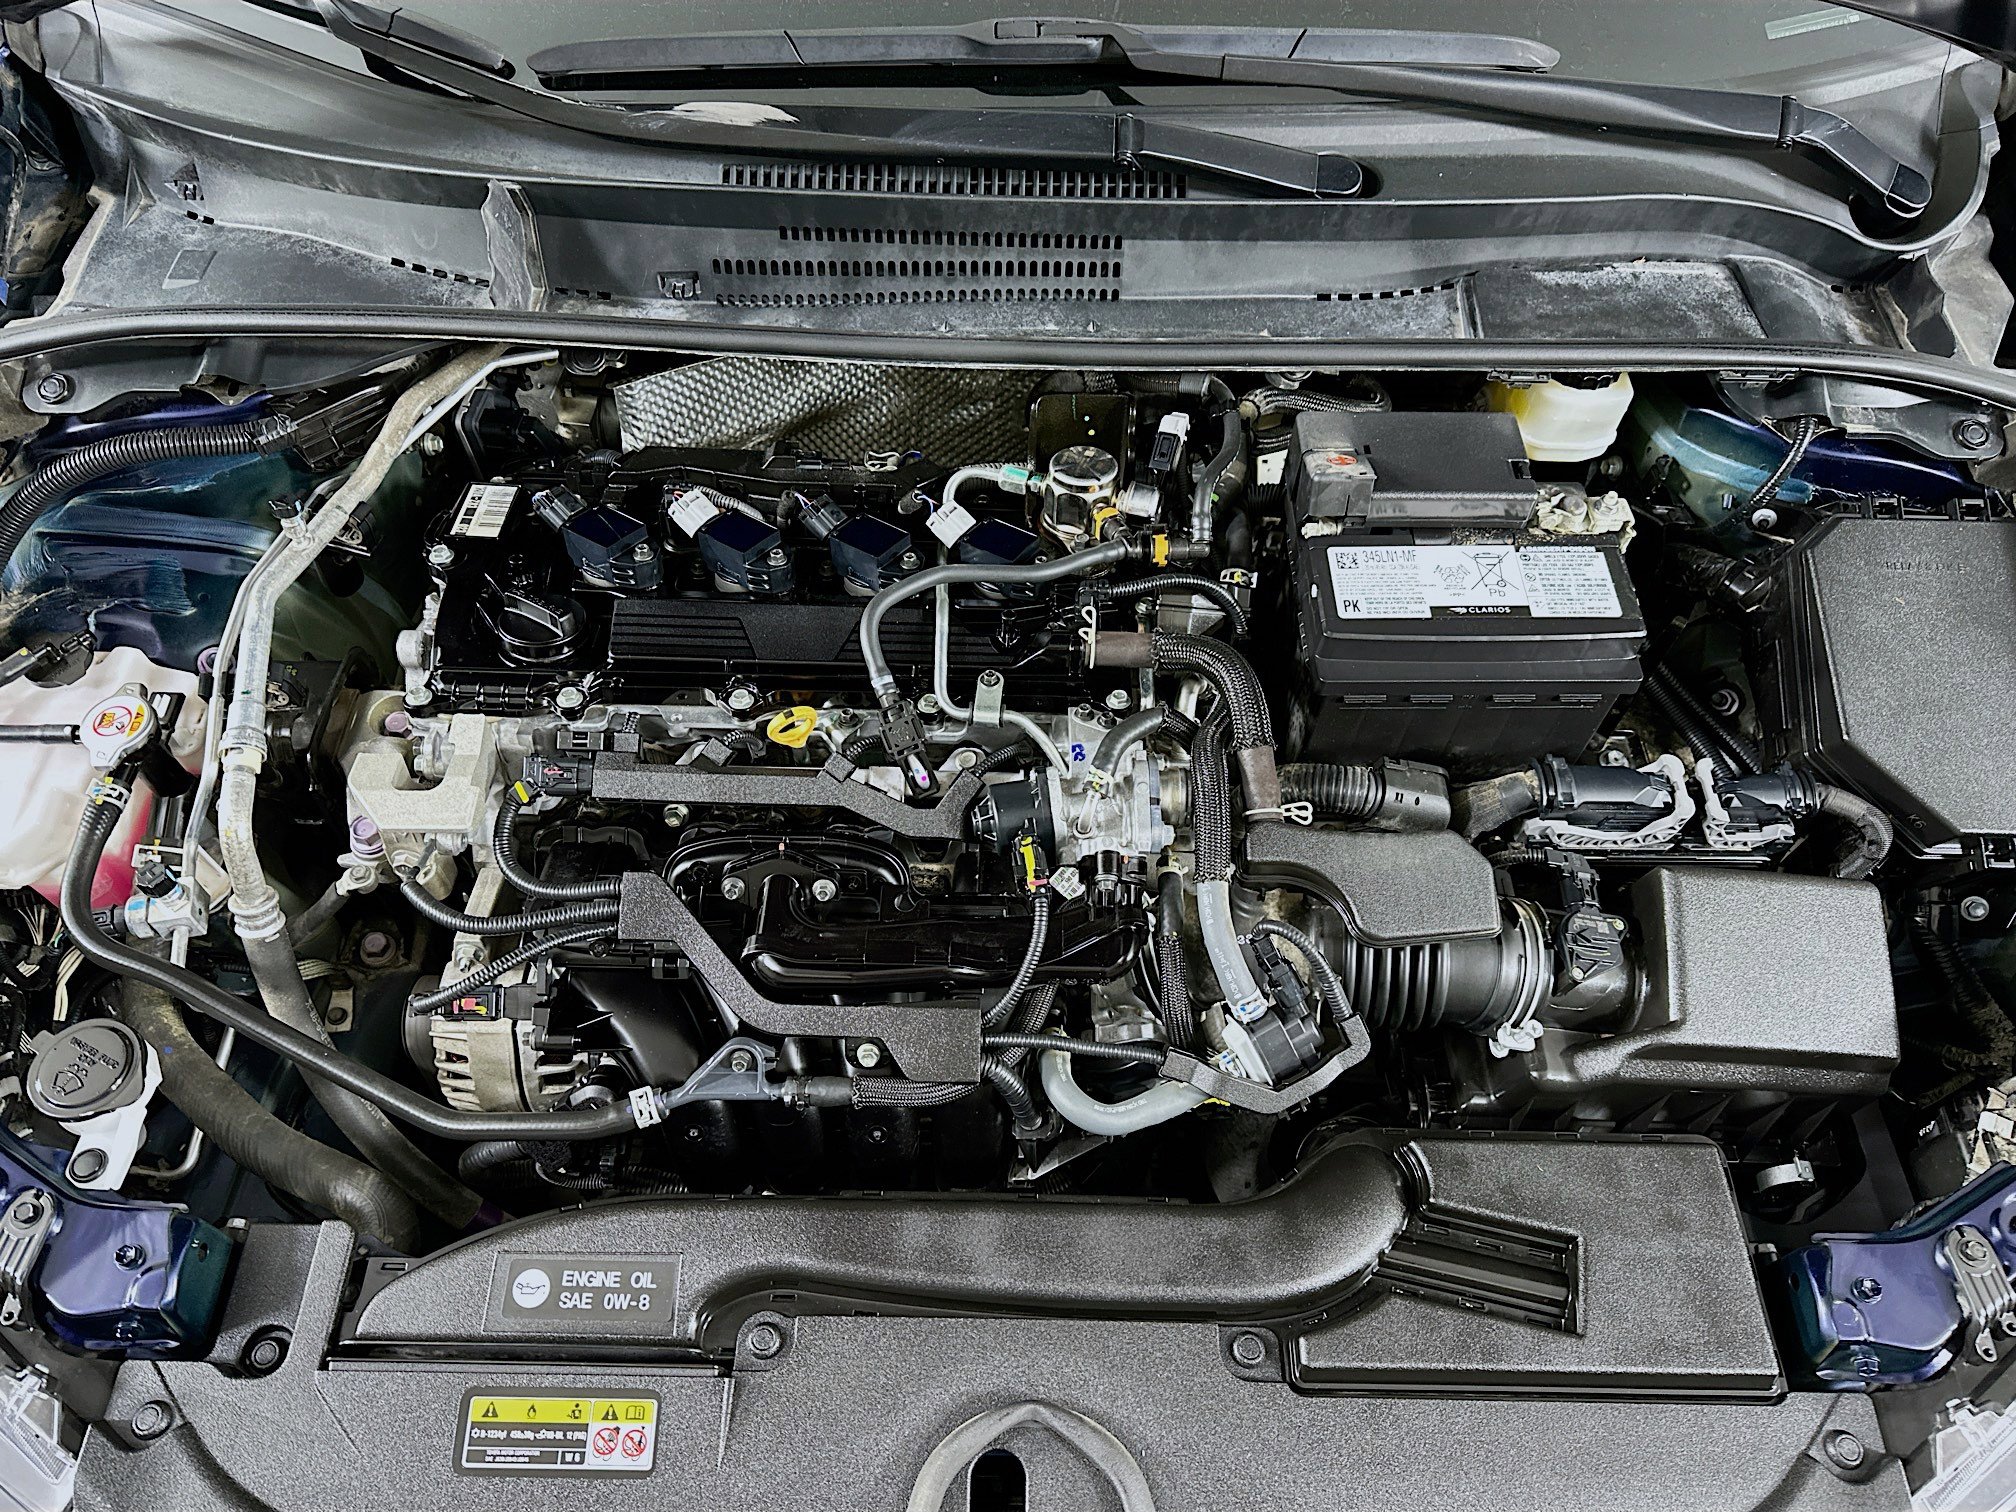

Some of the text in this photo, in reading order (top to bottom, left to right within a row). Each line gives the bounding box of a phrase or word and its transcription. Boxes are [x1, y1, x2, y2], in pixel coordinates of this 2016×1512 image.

[1489, 588, 1506, 598] Pb
[1343, 599, 1361, 613] PK
[1468, 606, 1512, 614] CLARIOS
[561, 1270, 658, 1289] ENGINE OIL
[558, 1292, 650, 1311] SAE 0W-8
